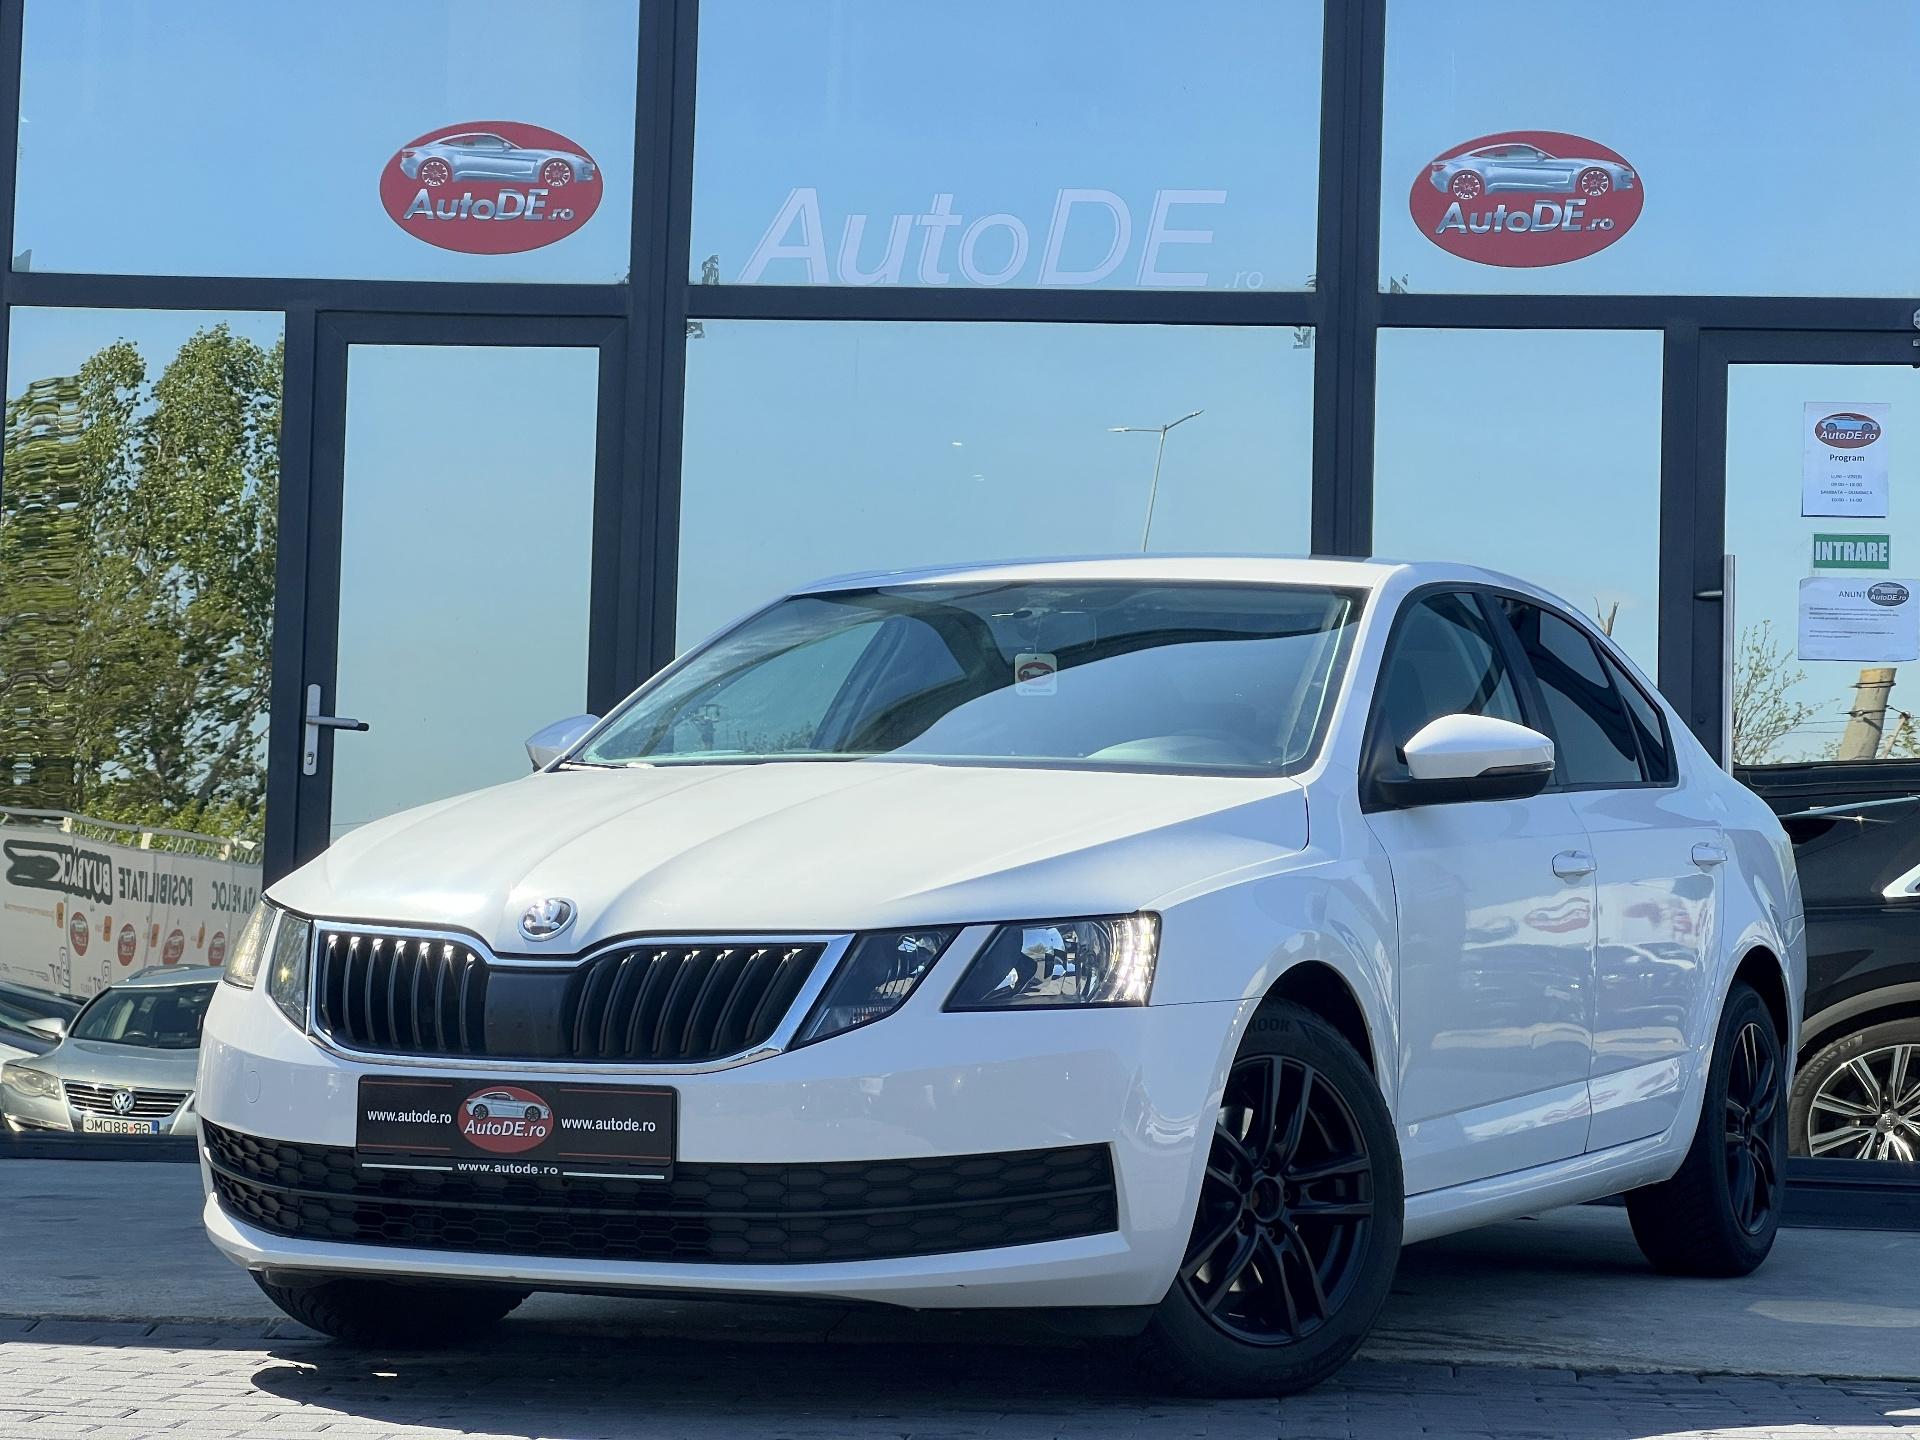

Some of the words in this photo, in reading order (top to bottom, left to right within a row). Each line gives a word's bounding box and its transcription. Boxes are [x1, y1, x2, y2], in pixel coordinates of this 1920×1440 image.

[1820, 430, 1876, 440] AutoDE.ro
[1829, 453, 1865, 463] Program
[1815, 541, 1888, 561] INTRARE
[367, 1110, 452, 1124] www.autode.ro
[464, 1119, 546, 1137] AutoDE.ro
[561, 1117, 656, 1132] www.autode.ro
[457, 1162, 558, 1175] www.autode.ro
